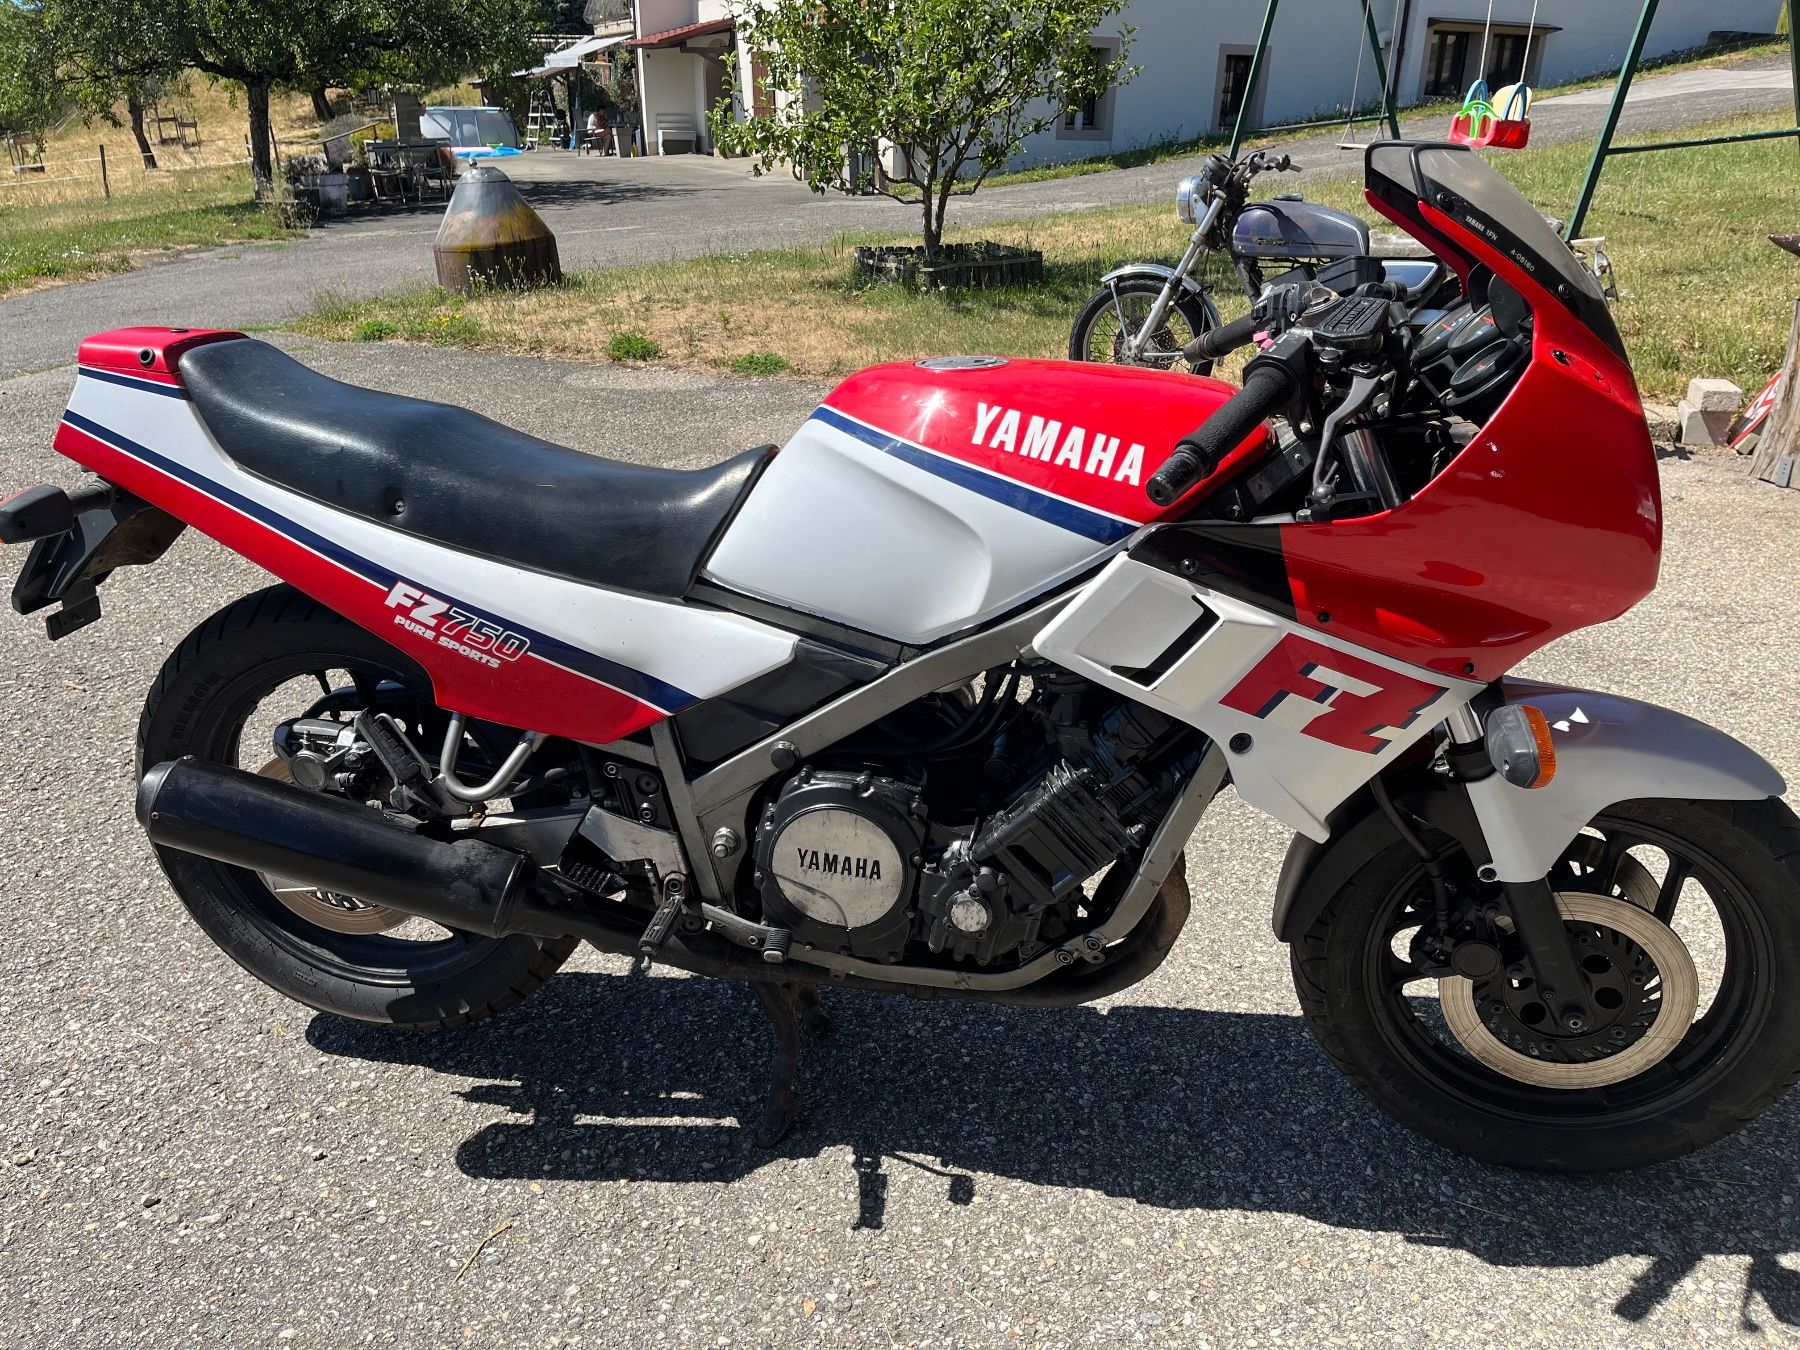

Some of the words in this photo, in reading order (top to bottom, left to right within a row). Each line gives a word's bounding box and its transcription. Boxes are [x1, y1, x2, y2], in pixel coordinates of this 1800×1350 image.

[1466, 215, 1485, 232] YAMAHA
[971, 402, 1145, 486] YAMAHA
[394, 615, 436, 640] PURE
[438, 636, 501, 669] SPORTS
[1218, 632, 1450, 755] FZ
[797, 848, 881, 880] YAMAHA
